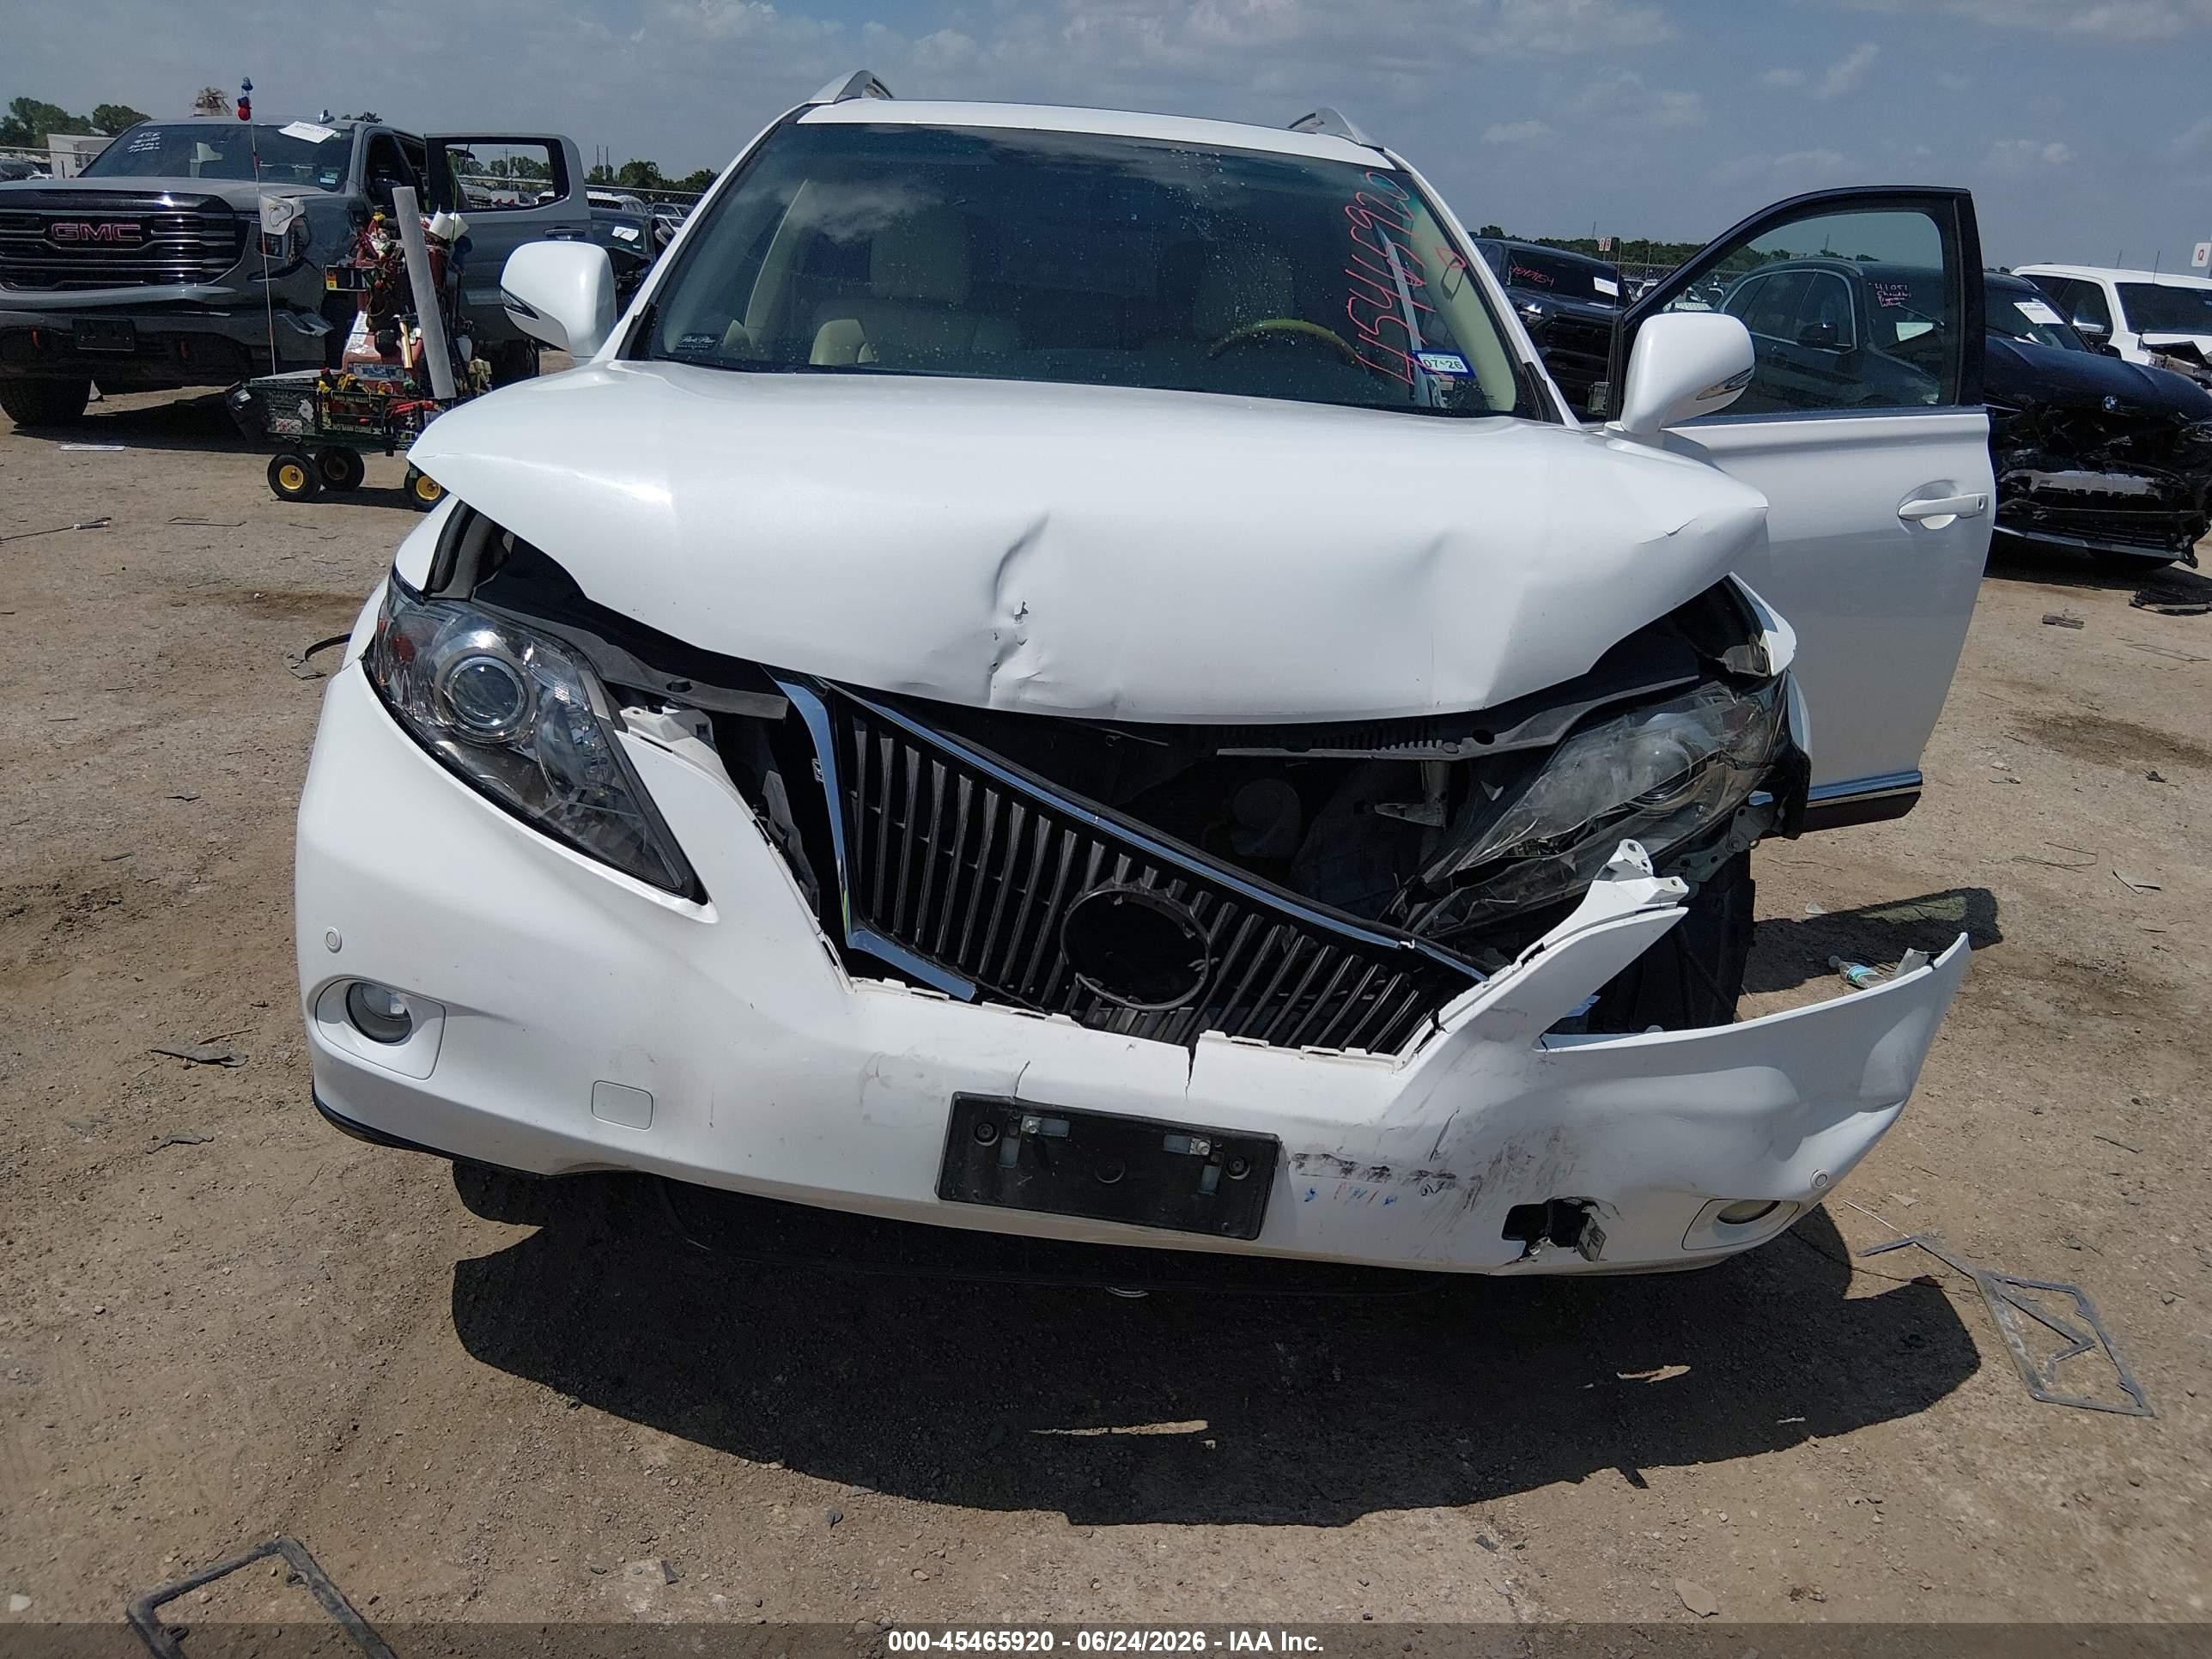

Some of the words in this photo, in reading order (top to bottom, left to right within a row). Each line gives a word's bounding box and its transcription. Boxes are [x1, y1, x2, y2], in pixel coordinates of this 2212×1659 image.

[51, 222, 143, 241] GMC
[2197, 248, 2205, 261] Q
[1423, 359, 1438, 368] 07
[1445, 360, 1463, 370] 26
